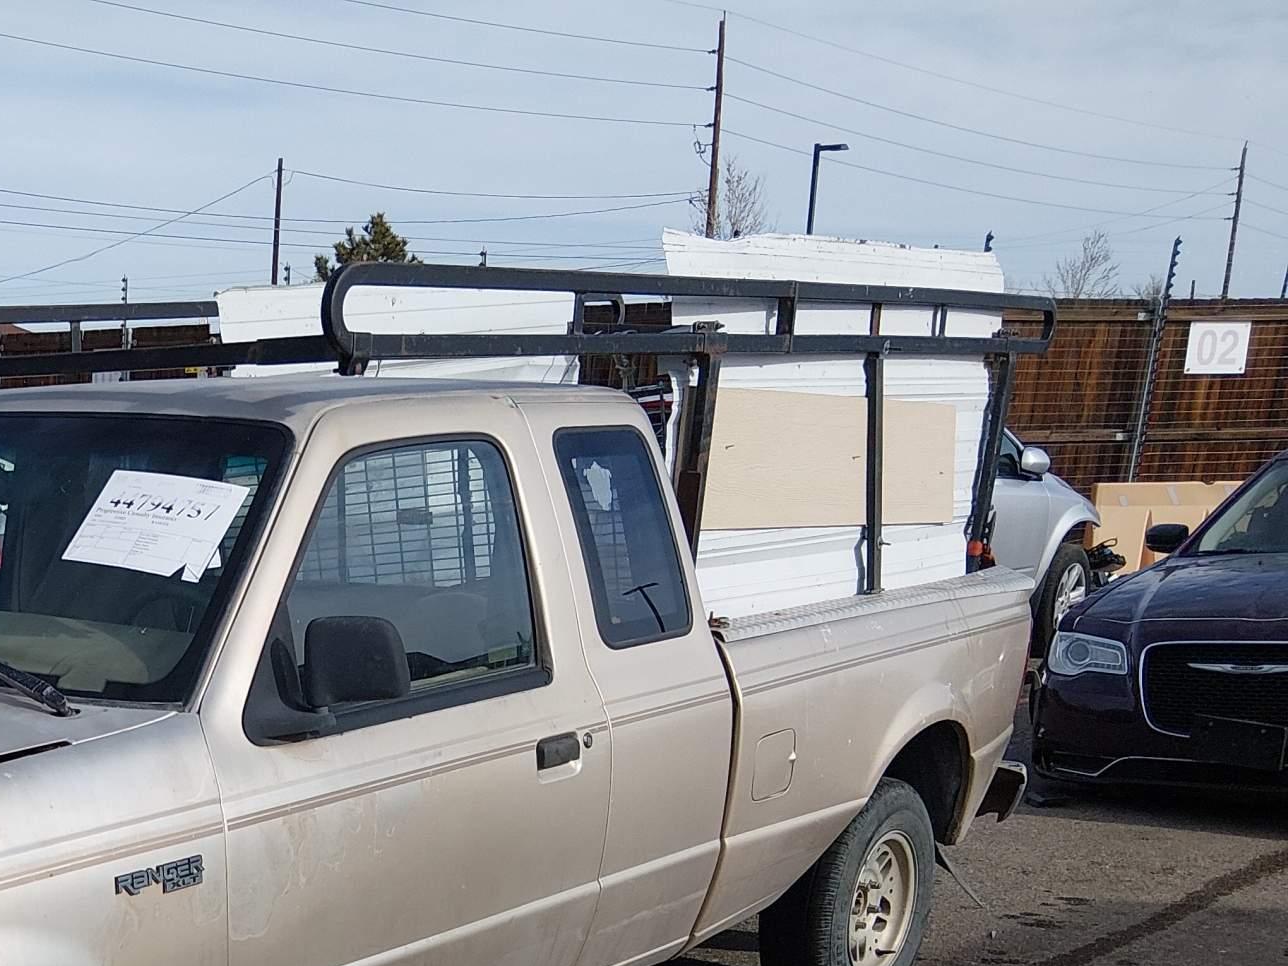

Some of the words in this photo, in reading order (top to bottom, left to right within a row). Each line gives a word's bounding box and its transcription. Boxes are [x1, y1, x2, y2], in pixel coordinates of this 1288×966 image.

[1197, 328, 1241, 366] 02
[114, 854, 205, 896] RANGER
[170, 875, 200, 890] XLT
